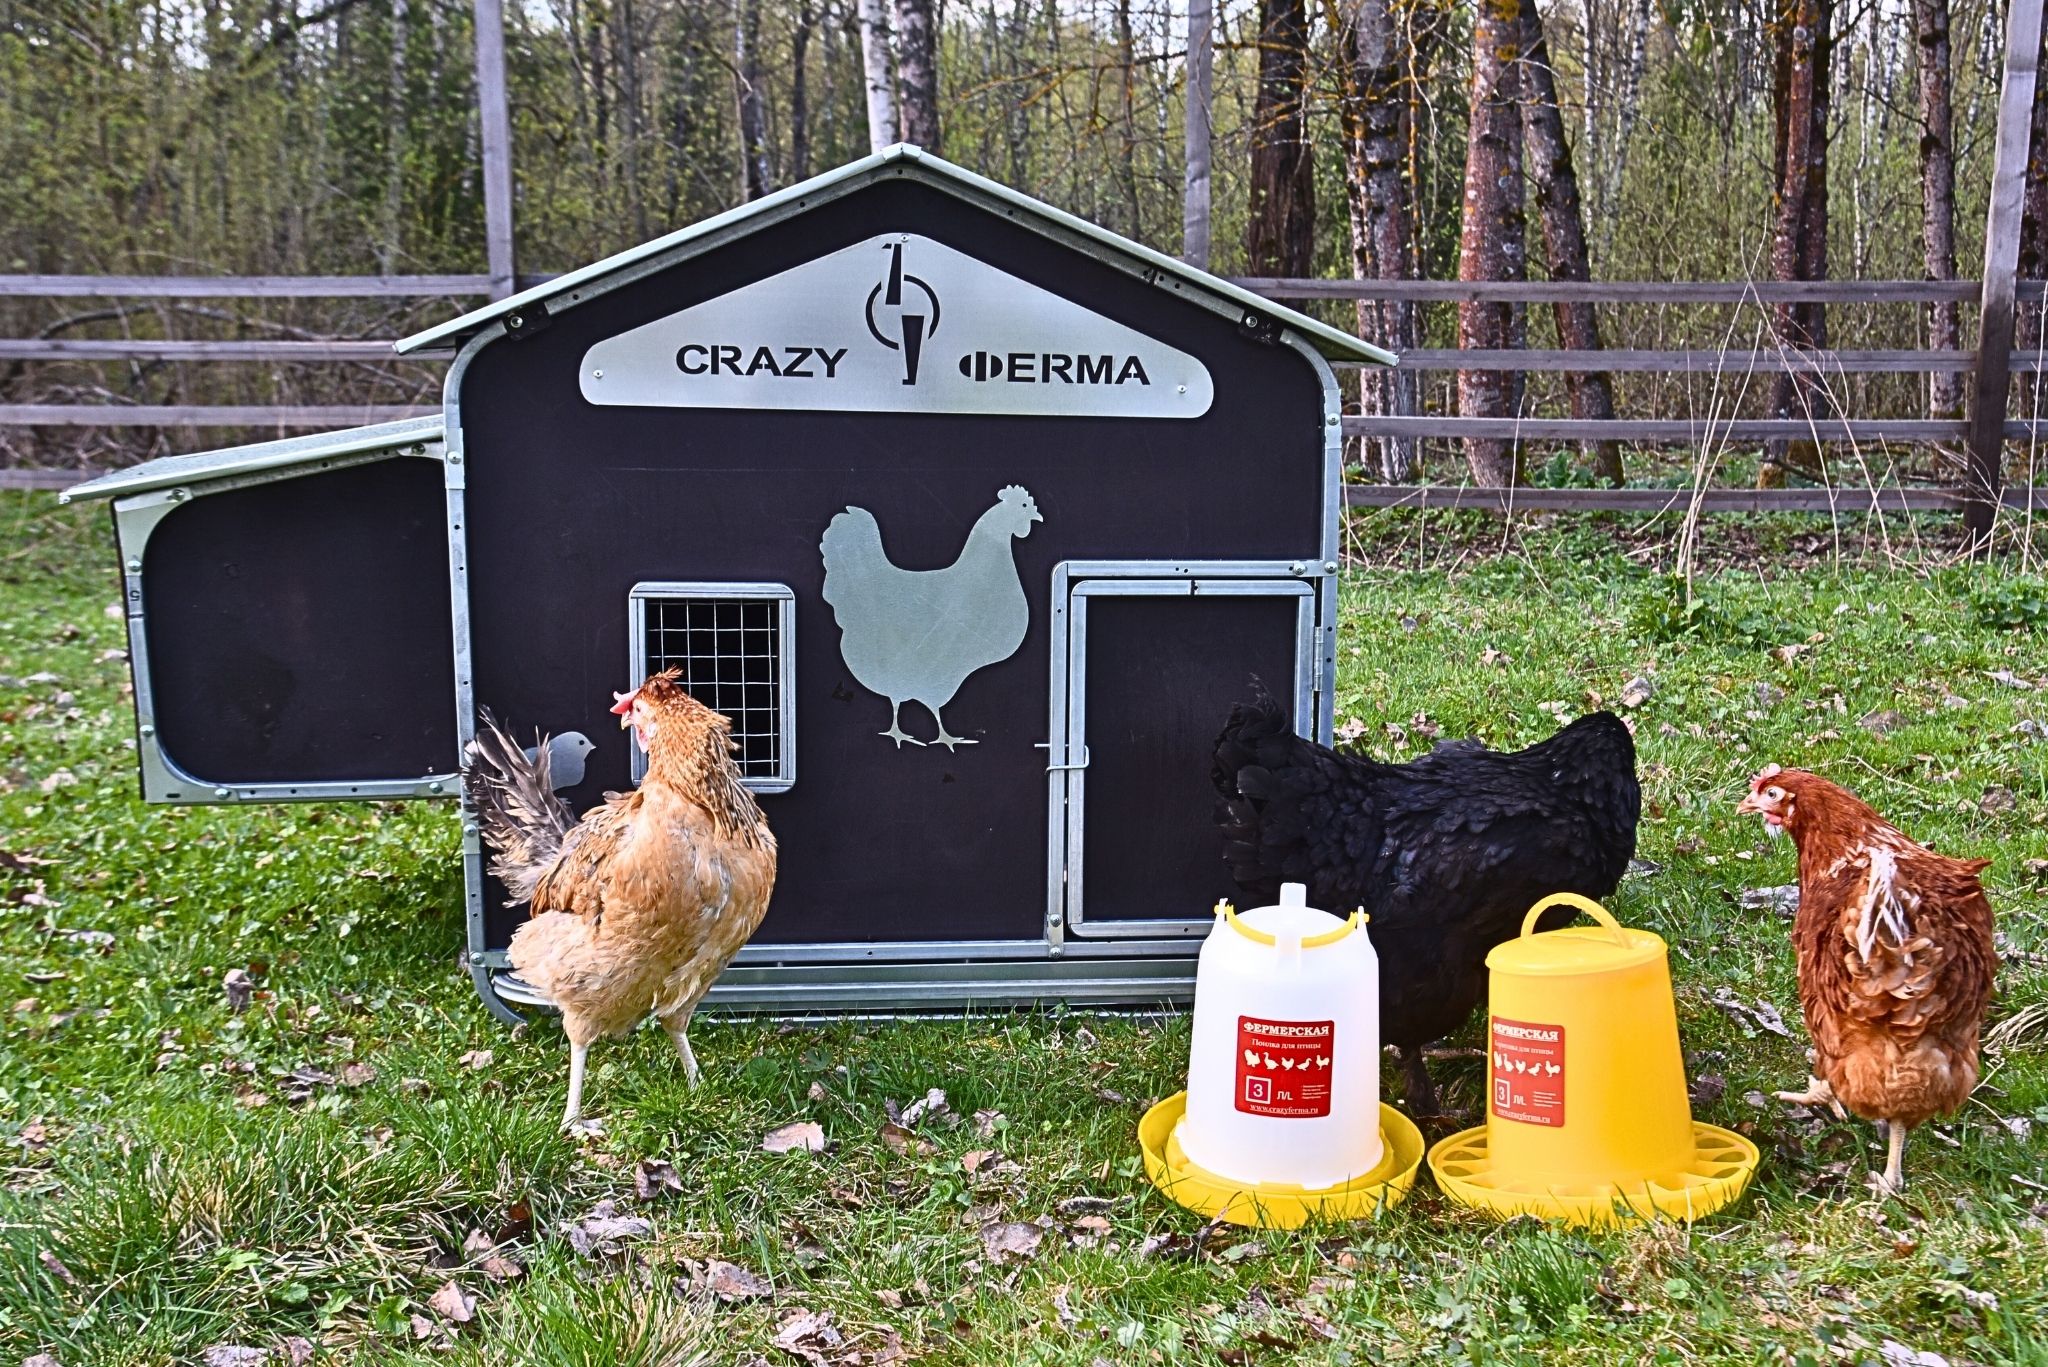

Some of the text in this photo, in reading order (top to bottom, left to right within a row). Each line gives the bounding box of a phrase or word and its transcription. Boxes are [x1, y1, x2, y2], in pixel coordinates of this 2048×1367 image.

[676, 344, 848, 378] CRAZY
[1243, 1022, 1329, 1036] ФЕРМЕРСКАЯ
[1253, 1084, 1263, 1097] 3
[1498, 1086, 1505, 1101] 3
[1250, 1104, 1318, 1115] www.crazyferma.ru
